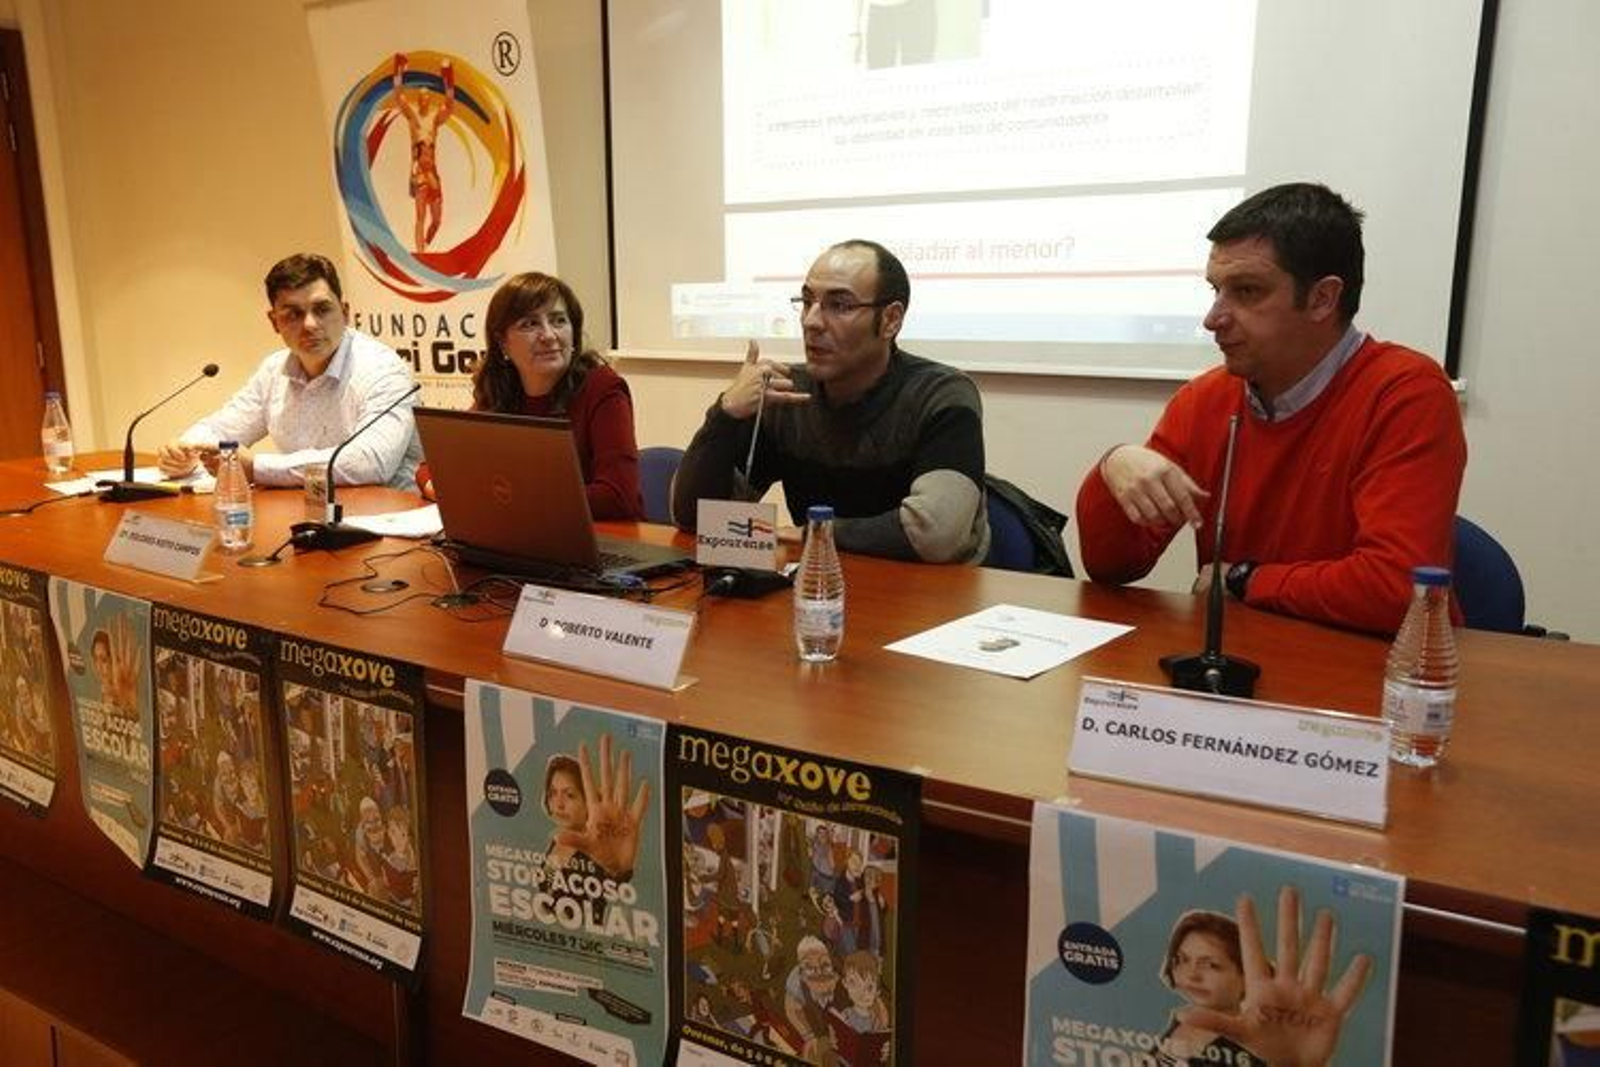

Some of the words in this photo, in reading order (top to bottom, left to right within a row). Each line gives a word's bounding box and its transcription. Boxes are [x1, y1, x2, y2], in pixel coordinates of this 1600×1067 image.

[965, 238, 983, 260] al
[989, 236, 1075, 260] menor?
[431, 341, 487, 374] Go
[153, 607, 248, 650] megaxove
[605, 630, 654, 649] VALENTE
[280, 640, 396, 688] megaxove
[678, 733, 872, 801] megaxove
[1082, 717, 1099, 732] D.
[1105, 720, 1177, 746] CARLOS
[1181, 732, 1299, 765] FERNÁNDEZ
[1303, 750, 1380, 778] GÓMEZ
[486, 859, 546, 888] STOP
[552, 869, 637, 905] ACOSO
[489, 882, 660, 948] ESCOLAR
[1063, 940, 1118, 957] ENTRADA
[1063, 950, 1120, 970] GRATIS
